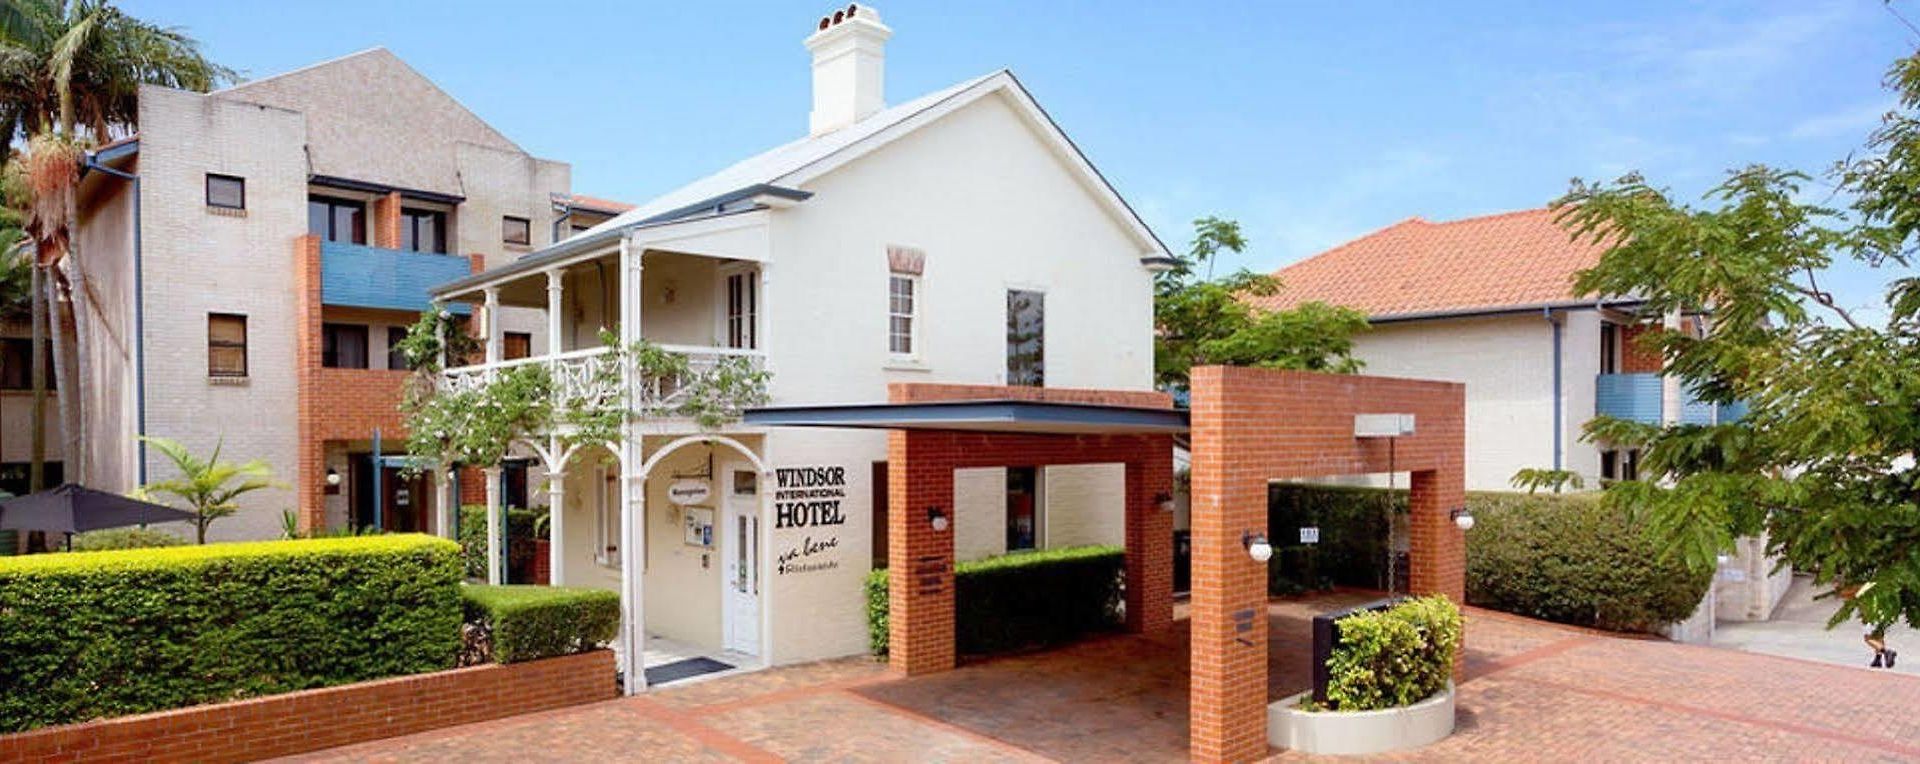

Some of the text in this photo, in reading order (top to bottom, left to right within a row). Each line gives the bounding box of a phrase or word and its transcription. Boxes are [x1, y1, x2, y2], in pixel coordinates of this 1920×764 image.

[775, 467, 845, 487] WINDSOR
[775, 488, 845, 499] INTERNATIONAL
[775, 500, 846, 528] HOTEL
